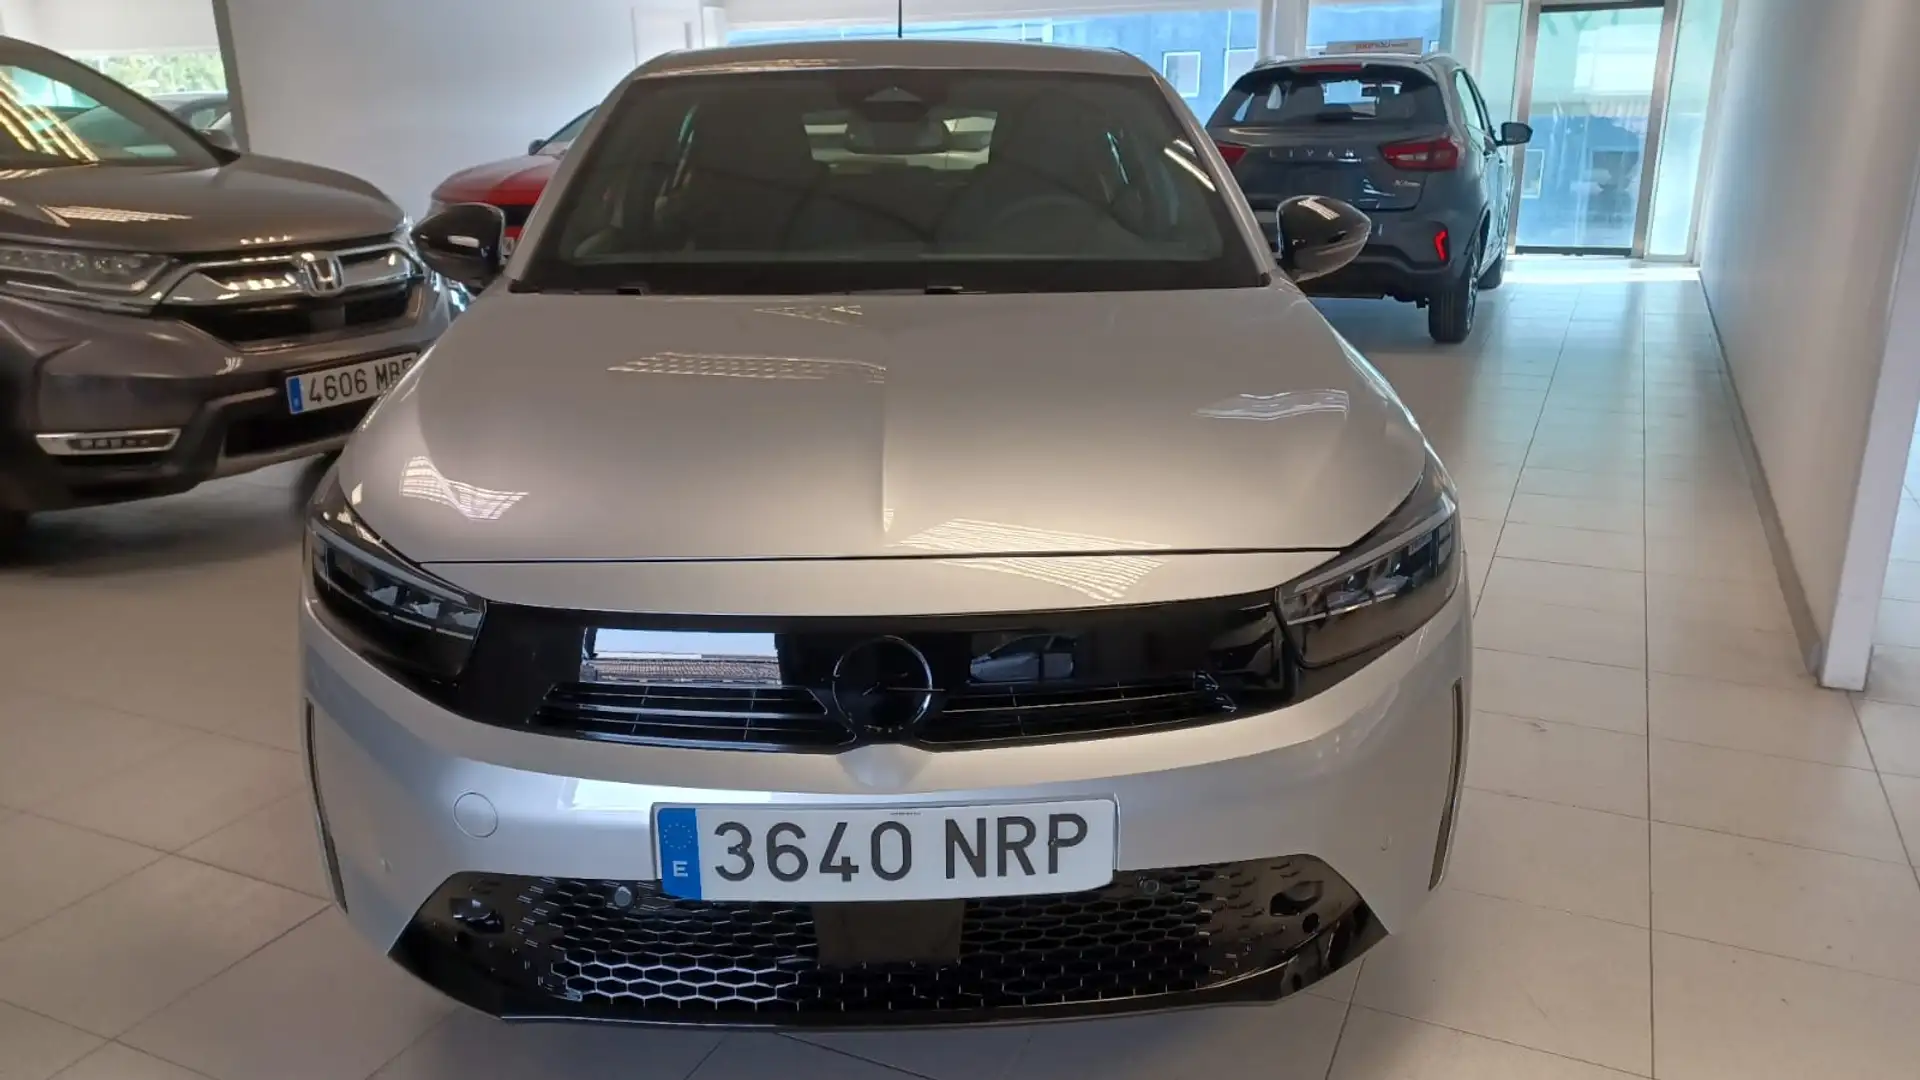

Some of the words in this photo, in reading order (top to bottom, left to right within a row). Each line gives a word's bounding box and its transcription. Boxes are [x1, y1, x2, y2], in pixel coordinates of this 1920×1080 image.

[309, 368, 367, 403] 4606
[713, 820, 912, 882] 3640
[944, 813, 1089, 879] NRP
[672, 860, 688, 877] E
